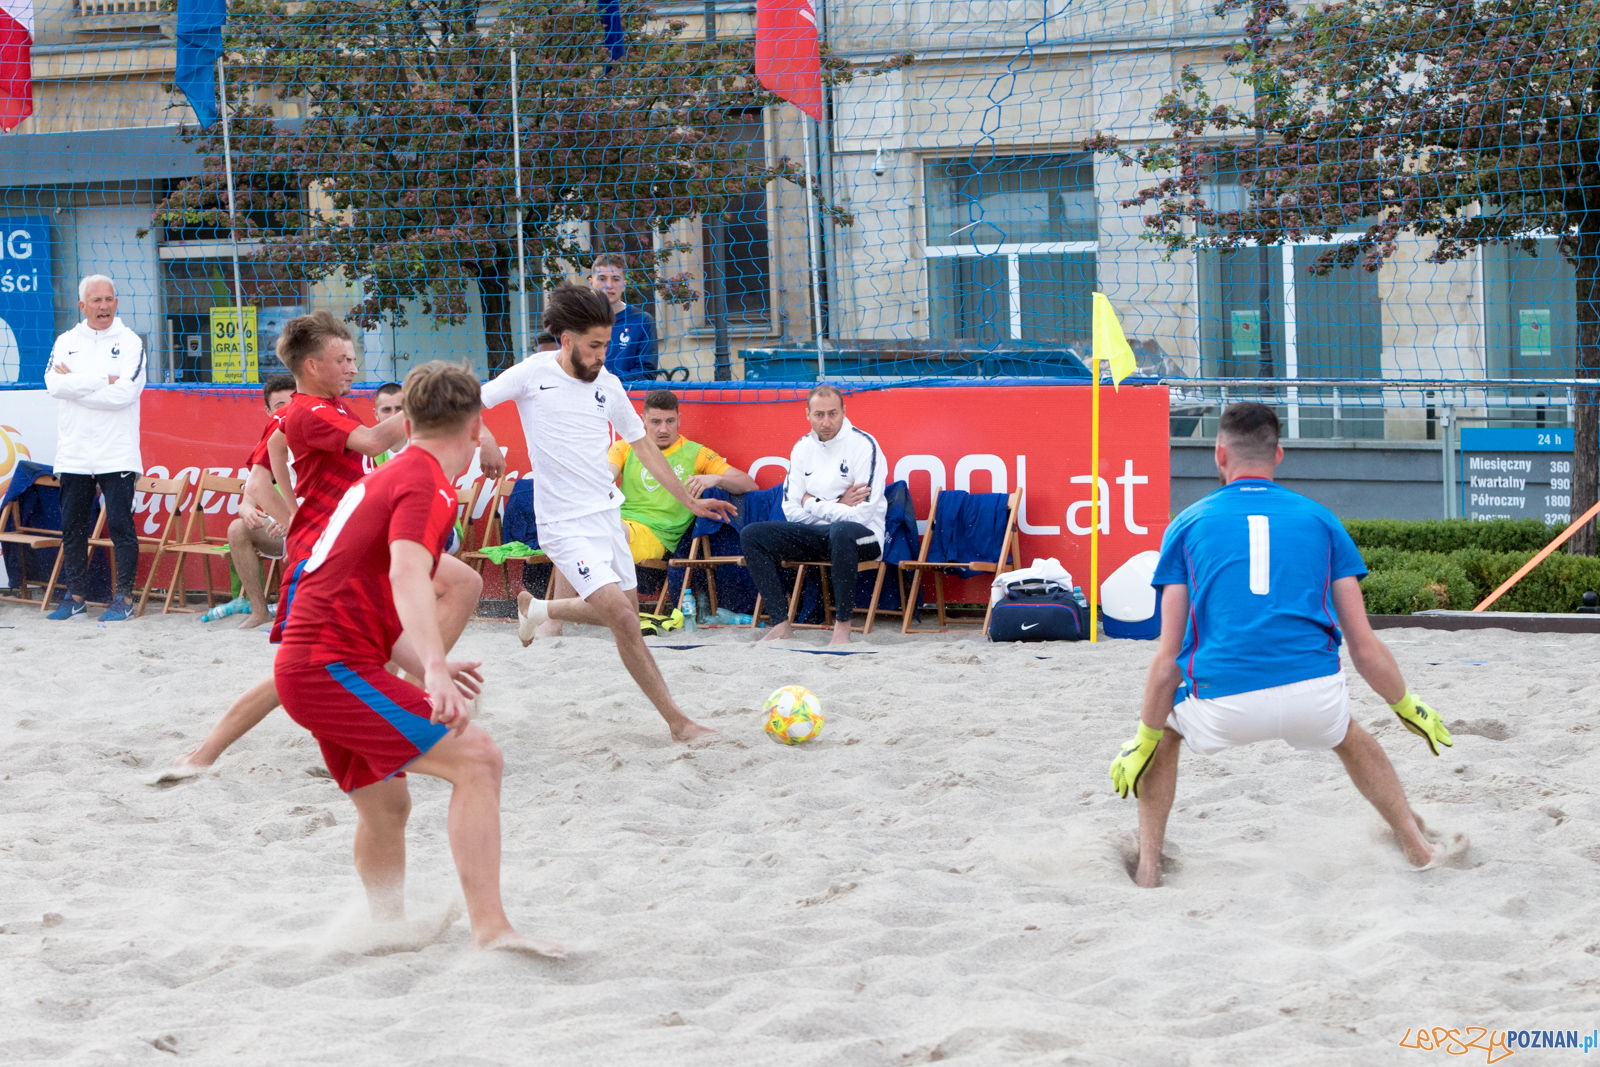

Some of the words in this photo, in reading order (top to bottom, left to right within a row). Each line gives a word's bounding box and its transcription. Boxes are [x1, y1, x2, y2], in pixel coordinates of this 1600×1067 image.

[1537, 433, 1551, 445] 24
[1555, 433, 1562, 445] h
[1469, 457, 1532, 473] Miesięczny
[1550, 461, 1570, 473] 360
[1470, 475, 1526, 491] Kwartalny
[1550, 478, 1570, 490] 990
[1470, 493, 1526, 509] Półroczny
[1544, 495, 1571, 507] 1800
[1247, 515, 1270, 595] 1
